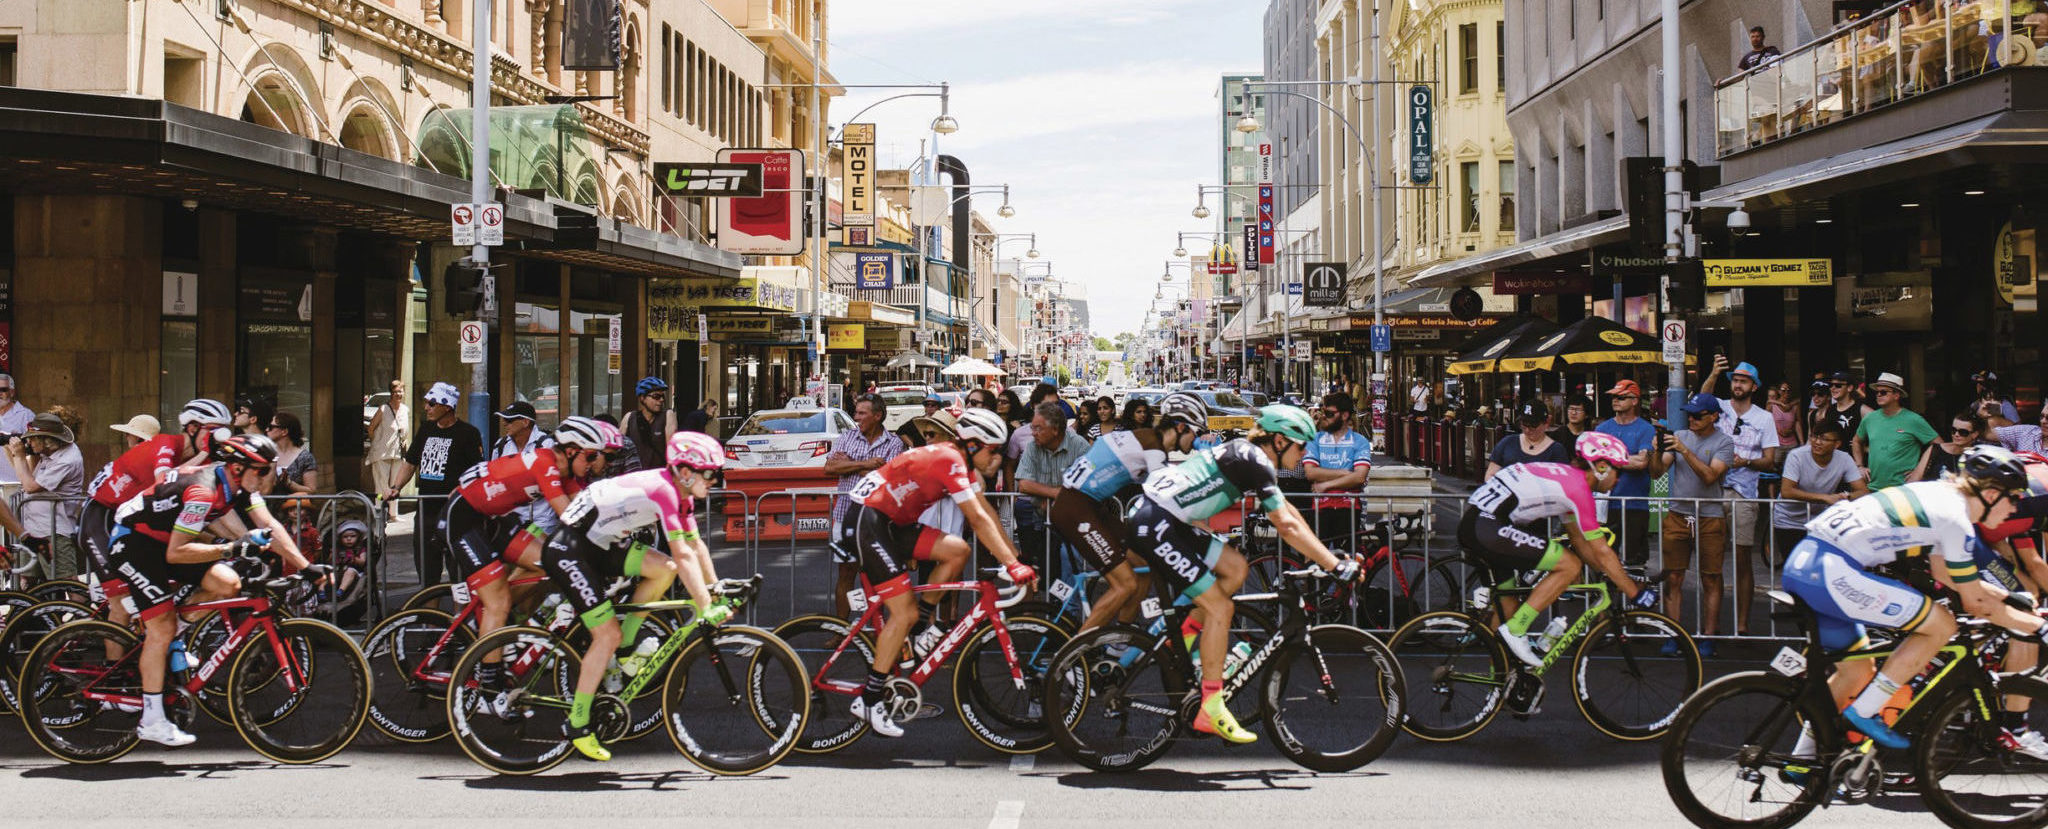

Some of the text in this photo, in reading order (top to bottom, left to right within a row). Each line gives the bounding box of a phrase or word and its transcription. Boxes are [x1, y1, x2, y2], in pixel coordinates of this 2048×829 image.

[1413, 92, 1428, 147] OPAL
[666, 168, 748, 191] UBET
[850, 146, 867, 211] MOTEL
[1247, 227, 1256, 261] POLITES
[1263, 237, 1271, 246] P
[1723, 264, 1802, 275] GUZMAN Y GOMEZ
[1309, 288, 1340, 298] millar
[1352, 317, 1418, 326] Gloria Coffees
[1421, 318, 1446, 326] Gloria
[419, 459, 447, 476] RACE
[421, 449, 449, 464] CYCLING
[151, 494, 179, 513] BMC
[1177, 476, 1225, 503] hansgrohe
[184, 502, 208, 513] TAG
[1082, 533, 1112, 566] MONDIALE
[1497, 524, 1546, 550] drapac
[459, 538, 482, 567] TREK
[871, 541, 899, 574] TREK
[1153, 541, 1201, 583] BORA
[117, 561, 165, 602] BMC
[557, 558, 598, 607] drapac
[1056, 582, 1070, 595] 91
[915, 602, 986, 676] TREK
[197, 634, 243, 683] BMC
[1222, 630, 1285, 704] S-WORKS
[1777, 653, 1801, 669] 187
[753, 662, 777, 730] BONTRAGER
[811, 720, 866, 749] BONTRAG
[961, 703, 1017, 748] BONTRAGER
